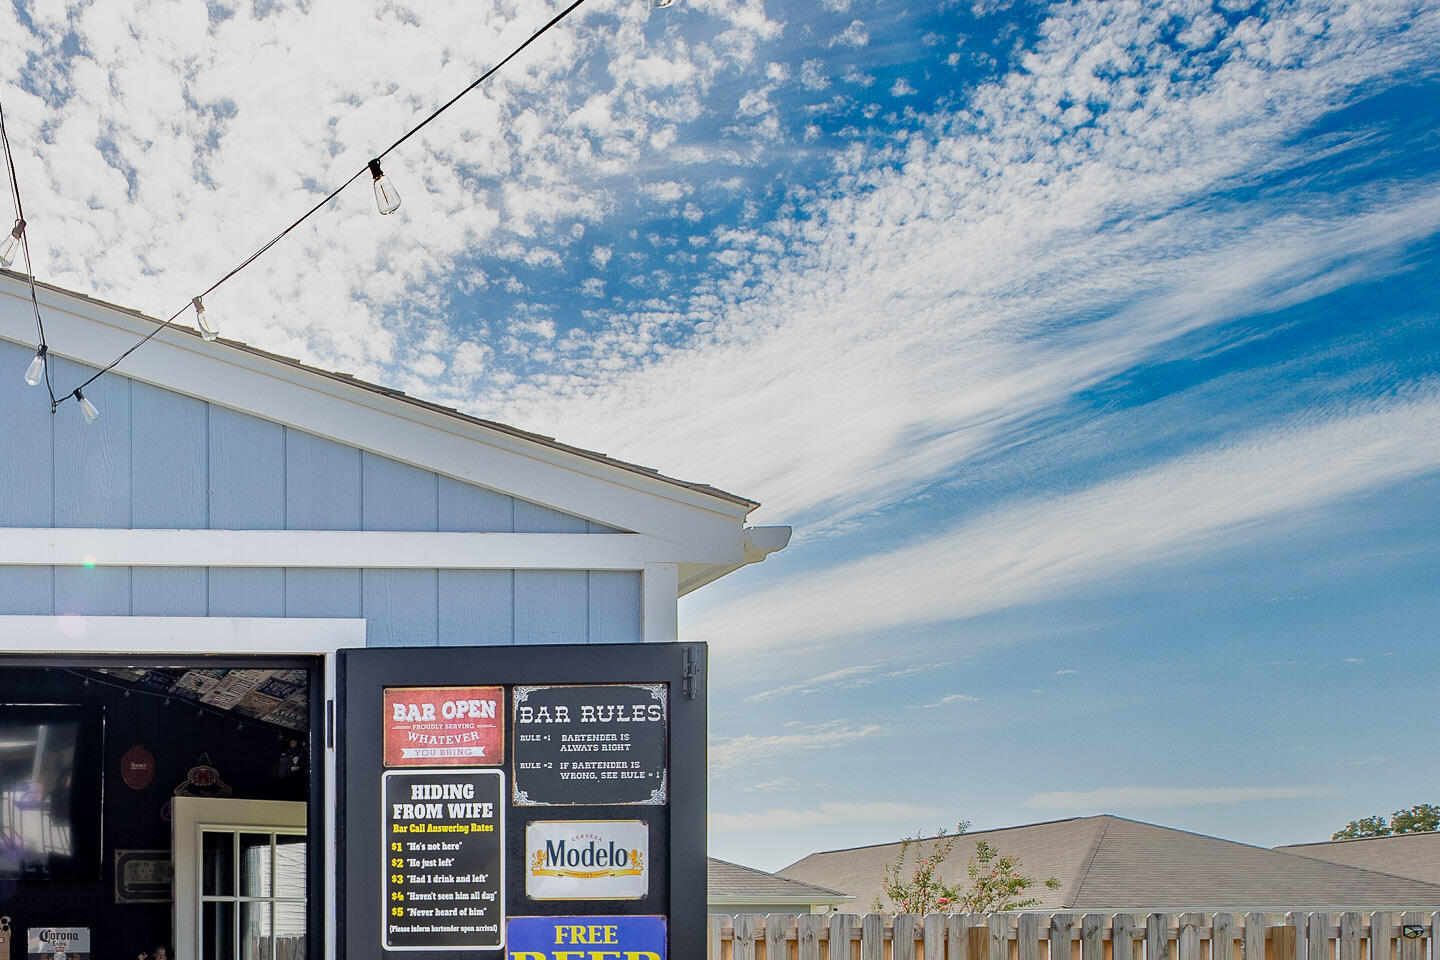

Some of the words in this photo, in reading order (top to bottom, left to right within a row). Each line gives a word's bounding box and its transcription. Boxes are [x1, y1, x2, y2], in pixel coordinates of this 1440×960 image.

[392, 702, 437, 722] BAR
[441, 699, 497, 719] OPEN
[519, 706, 571, 724] BAR
[580, 704, 662, 723] RULES
[408, 731, 480, 745] WHATEVER
[561, 733, 618, 742] BARTENDER
[620, 733, 630, 741] IS
[415, 749, 436, 757] YOU
[440, 748, 473, 756] BRING
[559, 744, 599, 752] ALWAYS
[601, 743, 631, 751] RIGHT
[559, 762, 569, 770] IF
[571, 762, 628, 770] BARTENDER
[630, 761, 641, 769] IS
[600, 771, 619, 779] SEE
[620, 771, 646, 779] RULE
[410, 784, 475, 800] HIDING
[393, 803, 443, 820] FROM
[447, 802, 494, 819] WIFE
[393, 824, 408, 833] Bar
[409, 824, 426, 832] Call
[427, 823, 469, 835] Answering
[470, 822, 494, 832] Rates
[571, 833, 603, 842] CERVEZA
[391, 842, 403, 852] $1
[546, 839, 628, 867] Modelo
[391, 858, 404, 868] $2
[421, 858, 437, 869] just
[391, 874, 404, 885] $3
[433, 874, 455, 884] drink
[456, 874, 471, 883] and
[391, 891, 405, 902] $4
[455, 891, 469, 900] him
[470, 891, 480, 900] all
[391, 906, 404, 917] $5
[435, 907, 458, 917] heard
[459, 907, 468, 916] of
[389, 925, 410, 934] (Please
[460, 926, 475, 934] upon
[475, 924, 498, 933] arrival)
[554, 925, 619, 944] FREE
[40, 929, 79, 943] Corona
